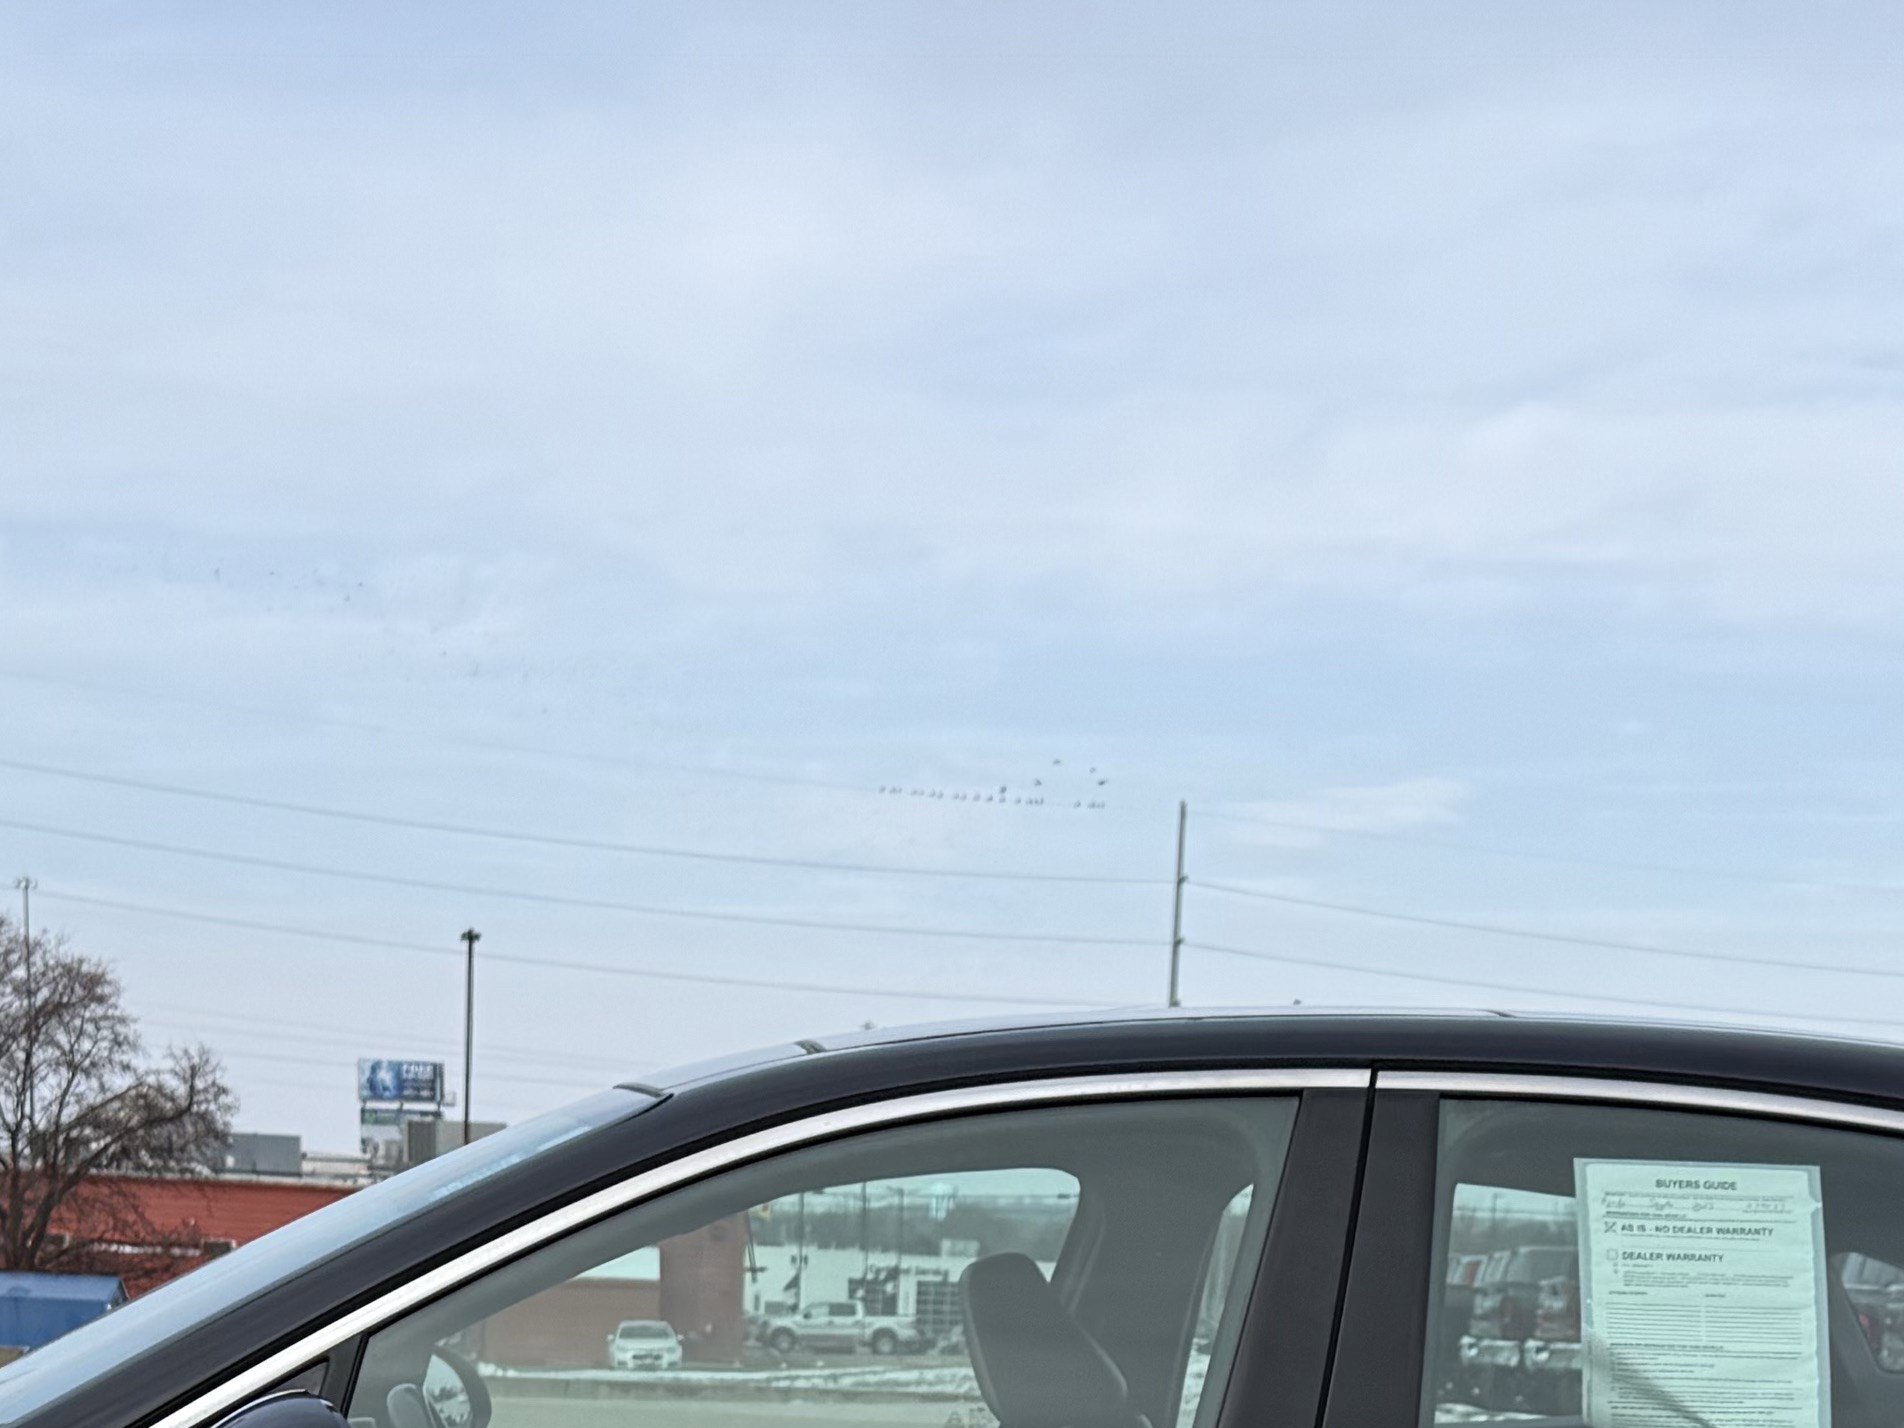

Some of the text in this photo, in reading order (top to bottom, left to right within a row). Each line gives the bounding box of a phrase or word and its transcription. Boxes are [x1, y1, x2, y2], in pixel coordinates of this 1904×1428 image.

[1655, 1178, 1738, 1191] BUYERS GUIDE
[1621, 1224, 1634, 1233] AS
[1637, 1225, 1647, 1233] IS
[1655, 1225, 1670, 1234] NO
[1672, 1225, 1713, 1235] DEALER
[1716, 1227, 1774, 1237] WARRANTY
[1622, 1251, 1724, 1262] DEALER WARRANTY
